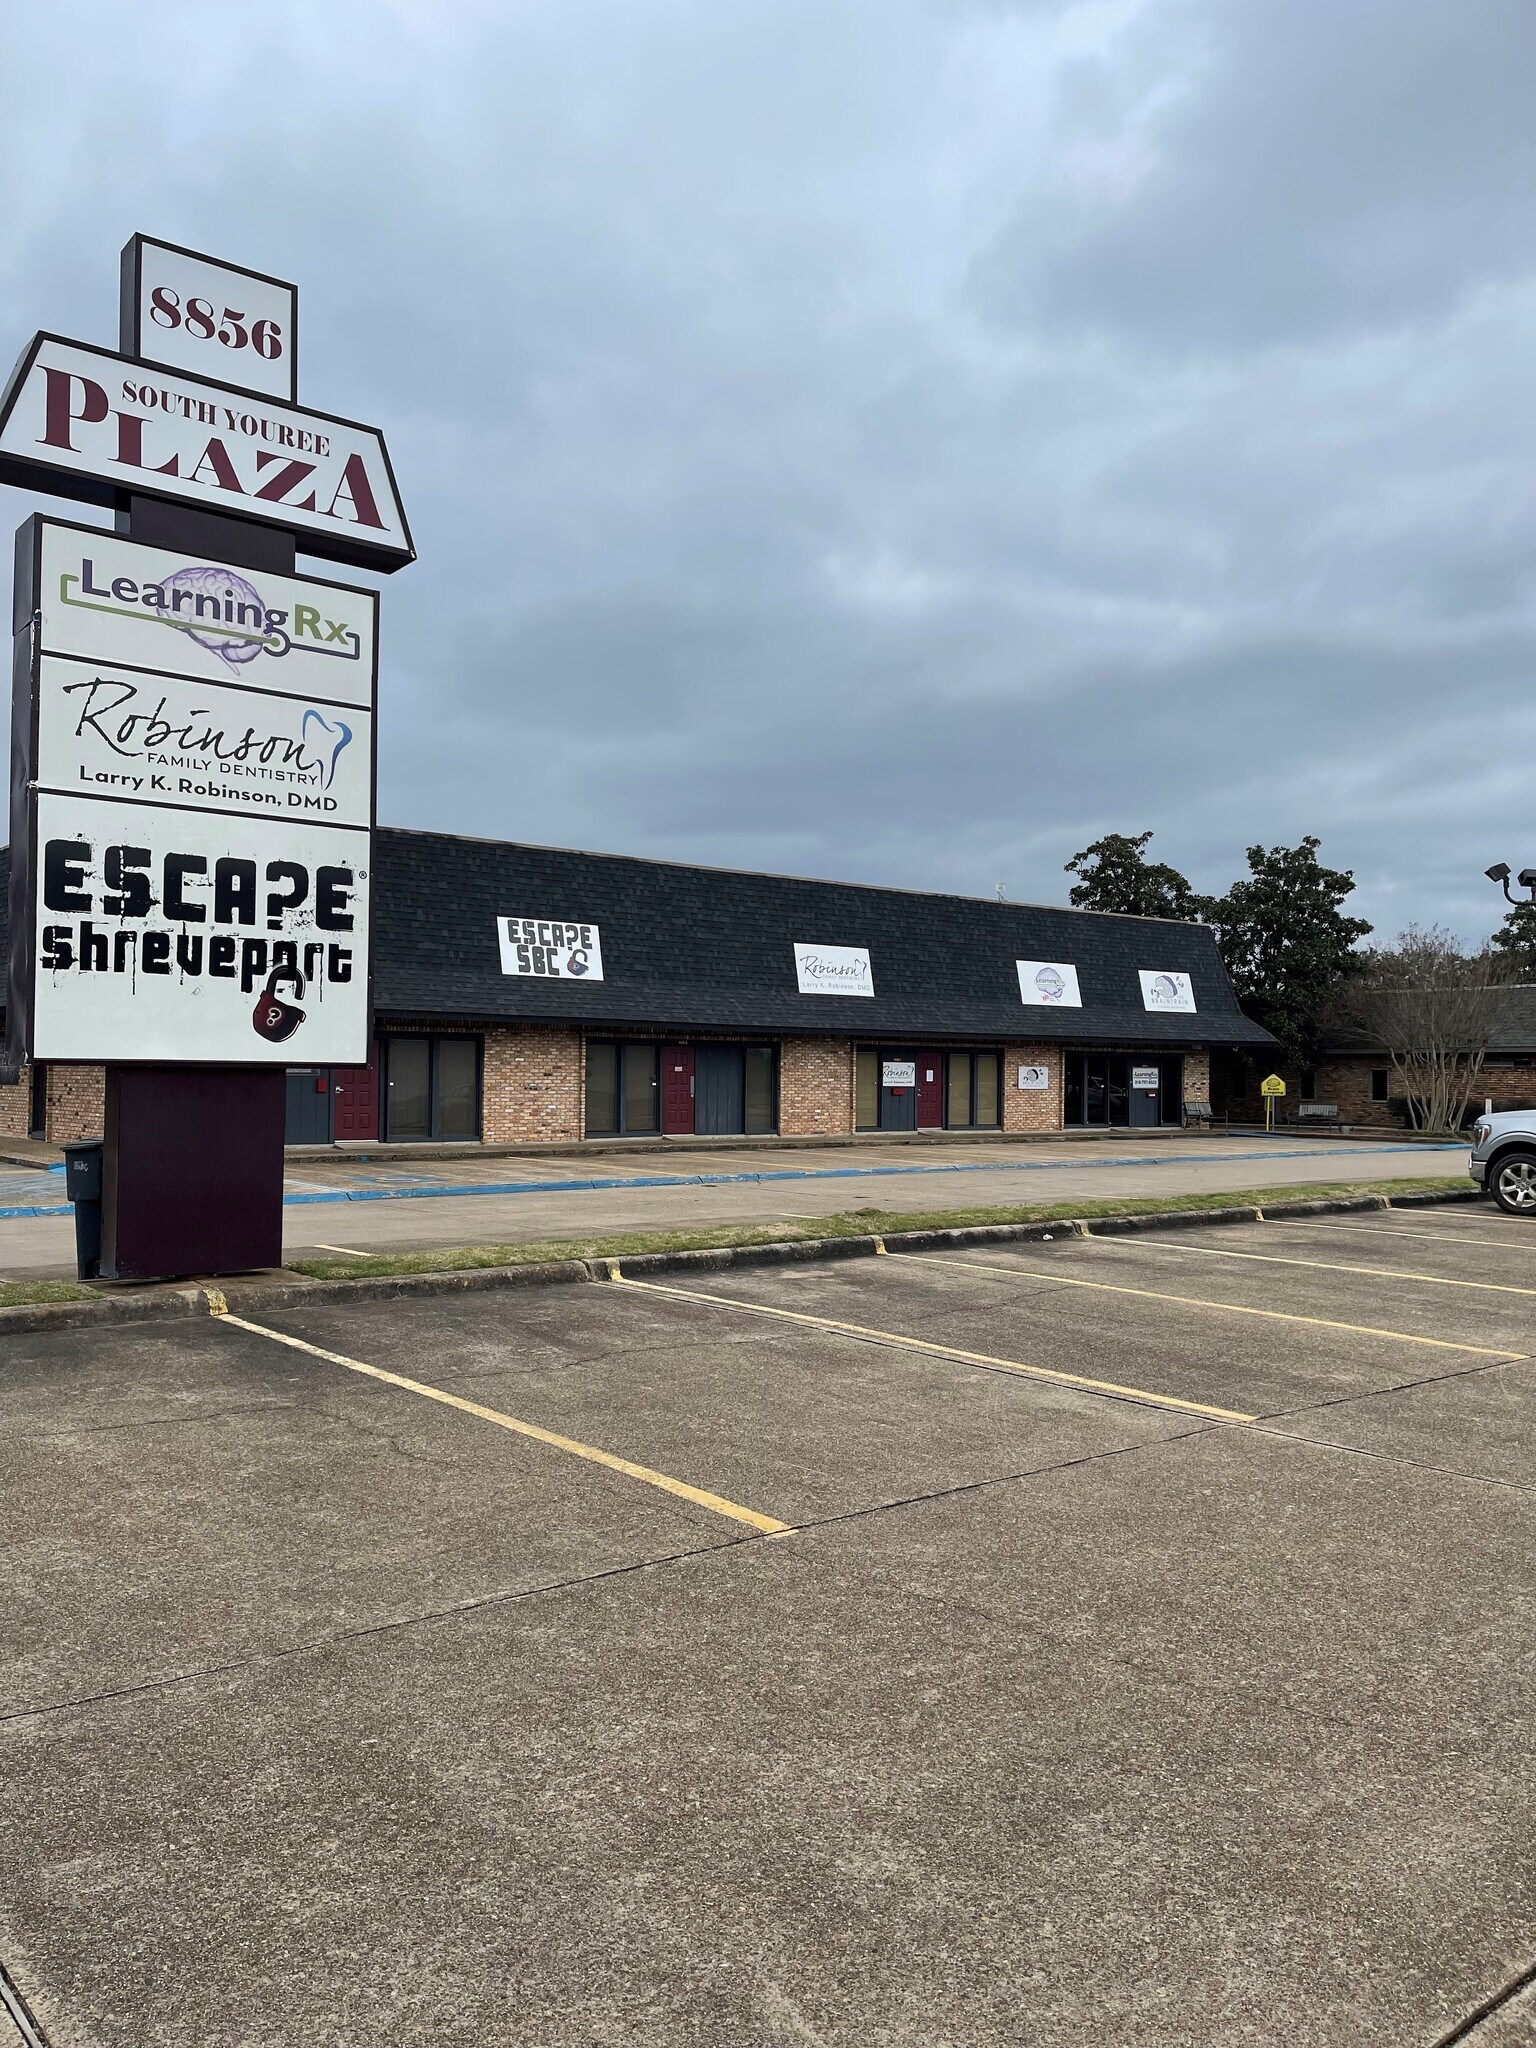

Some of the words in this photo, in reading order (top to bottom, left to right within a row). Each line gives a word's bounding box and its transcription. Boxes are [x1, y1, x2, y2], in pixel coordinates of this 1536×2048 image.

[149, 286, 283, 361] 8856
[121, 380, 217, 427] SOUTH
[223, 407, 331, 458] YOUREE
[35, 364, 391, 532] PLAZA
[81, 558, 349, 656] LearningRx
[63, 677, 318, 771] Robinson
[80, 765, 144, 790] Larry
[150, 775, 173, 792] K.
[178, 778, 282, 807] Robinson,
[287, 793, 338, 812] DMD
[146, 752, 212, 771] FAMILY
[219, 762, 319, 786] DENTISTRY
[517, 944, 560, 976] SBC
[800, 955, 859, 979] Robinson
[802, 981, 818, 989] Larry
[1151, 997, 1189, 1005] BRAINTRAIN
[266, 1007, 282, 1025] ?
